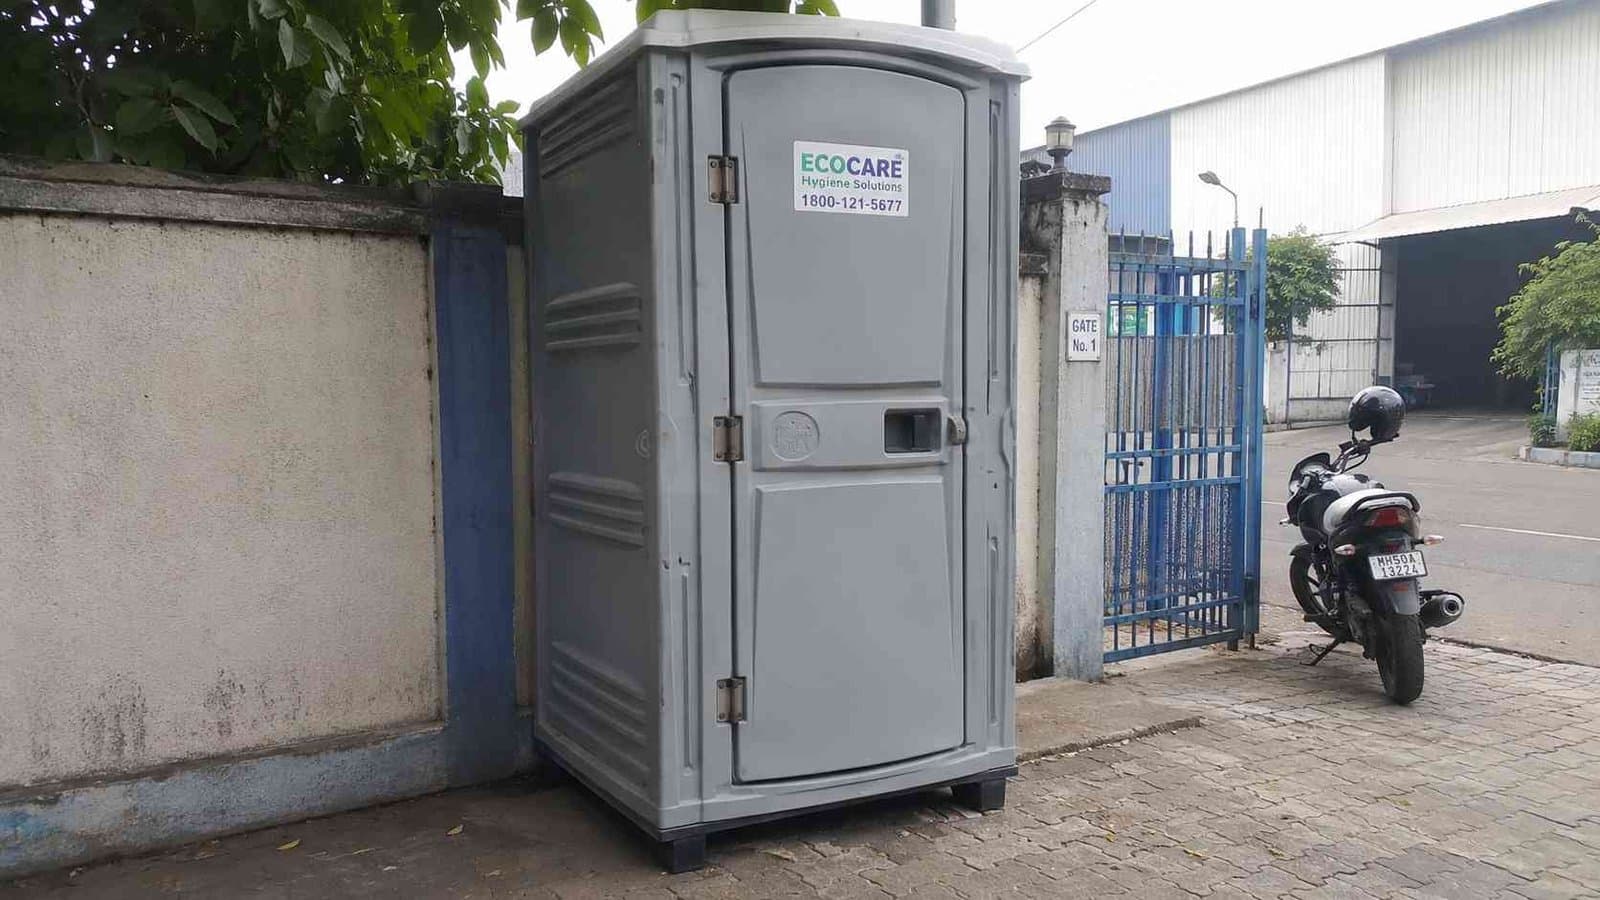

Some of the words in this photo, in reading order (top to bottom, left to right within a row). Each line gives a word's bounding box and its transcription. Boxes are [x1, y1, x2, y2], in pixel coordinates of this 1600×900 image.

[801, 152, 902, 178] ECOCARE
[802, 176, 850, 189] Hygiene
[853, 179, 902, 192] Solutions
[802, 194, 902, 212] 1800-121-5677
[1072, 319, 1097, 333] GATE
[1072, 338, 1088, 352] No.
[1091, 338, 1096, 352] 1
[1377, 553, 1416, 567] MH50A
